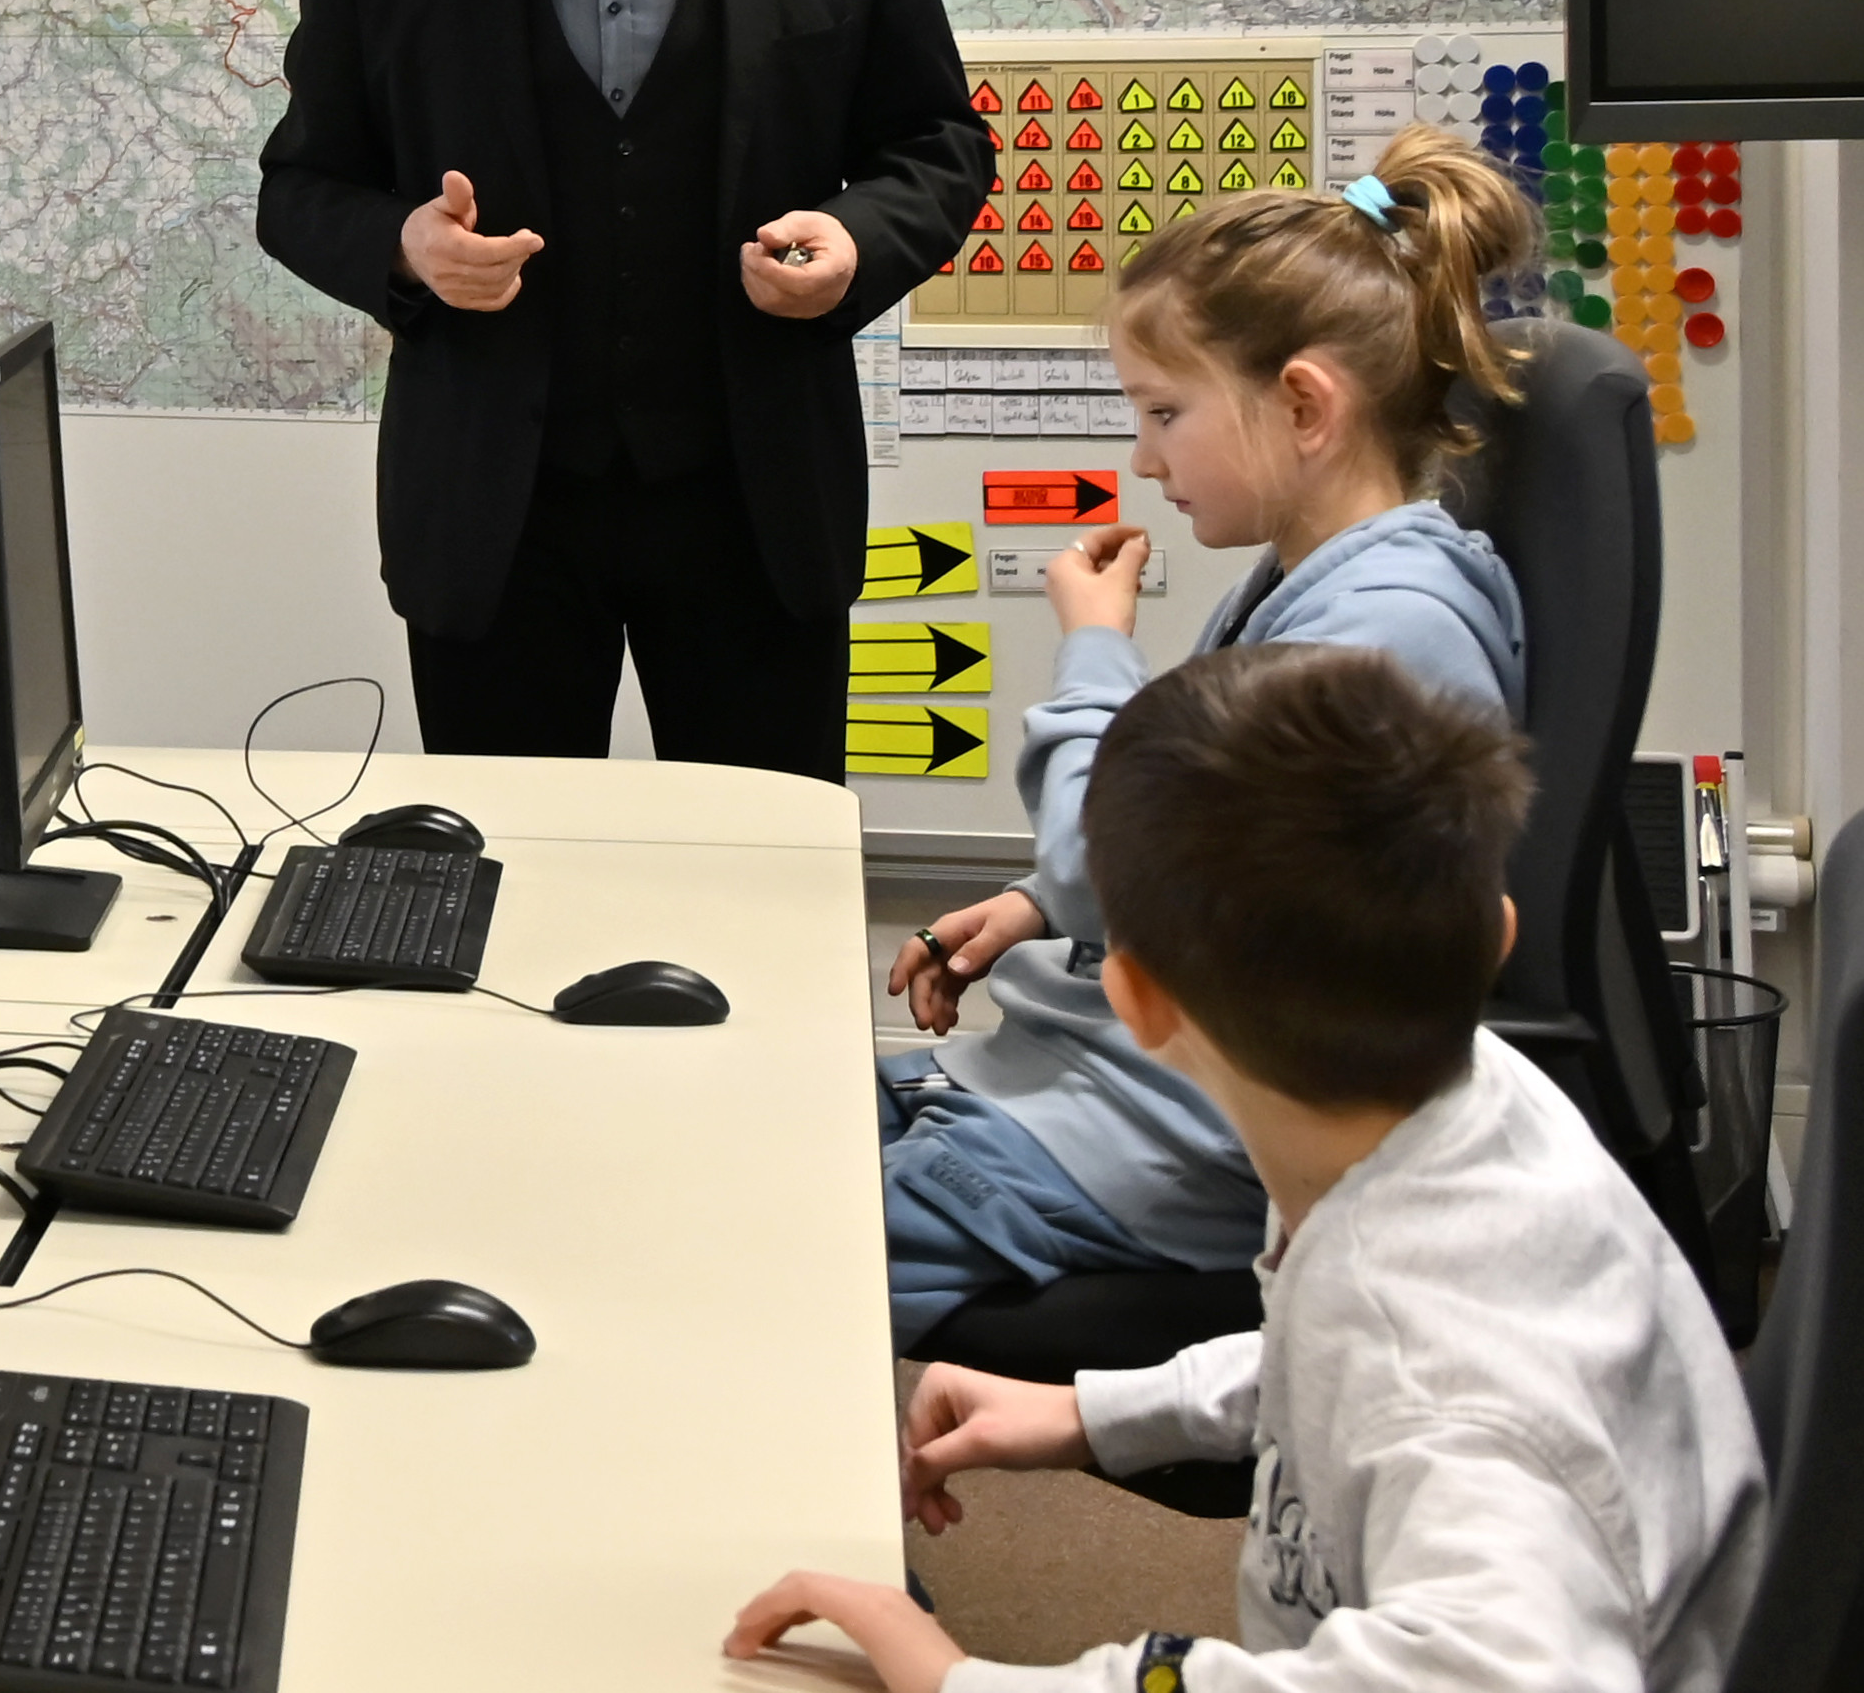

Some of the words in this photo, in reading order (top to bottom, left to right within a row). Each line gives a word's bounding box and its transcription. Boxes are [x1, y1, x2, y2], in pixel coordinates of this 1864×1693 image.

[1330, 67, 1353, 75] Stand
[981, 94, 990, 110] 6
[1031, 94, 1044, 110] 11
[1080, 92, 1094, 108] 16
[1134, 92, 1140, 108] 1
[1181, 92, 1189, 109] 6
[1231, 90, 1244, 106] 11
[1281, 89, 1296, 105] 16
[1027, 130, 1040, 147] 12
[1080, 130, 1094, 147] 17
[1132, 132, 1141, 148] 2
[1182, 131, 1189, 148] 7
[1231, 131, 1245, 148] 12
[1280, 129, 1295, 146] 17
[1031, 172, 1045, 187] 13
[1081, 172, 1095, 187] 18
[1132, 171, 1140, 187] 3
[1181, 175, 1189, 191] 8
[1231, 172, 1245, 187] 13
[1281, 170, 1295, 186] 18
[983, 212, 991, 228] 9
[1029, 212, 1043, 228] 14
[1080, 210, 1094, 225] 19
[1131, 214, 1140, 231] 4
[979, 255, 994, 270] 10
[1030, 252, 1044, 268] 15
[1079, 251, 1095, 268] 20
